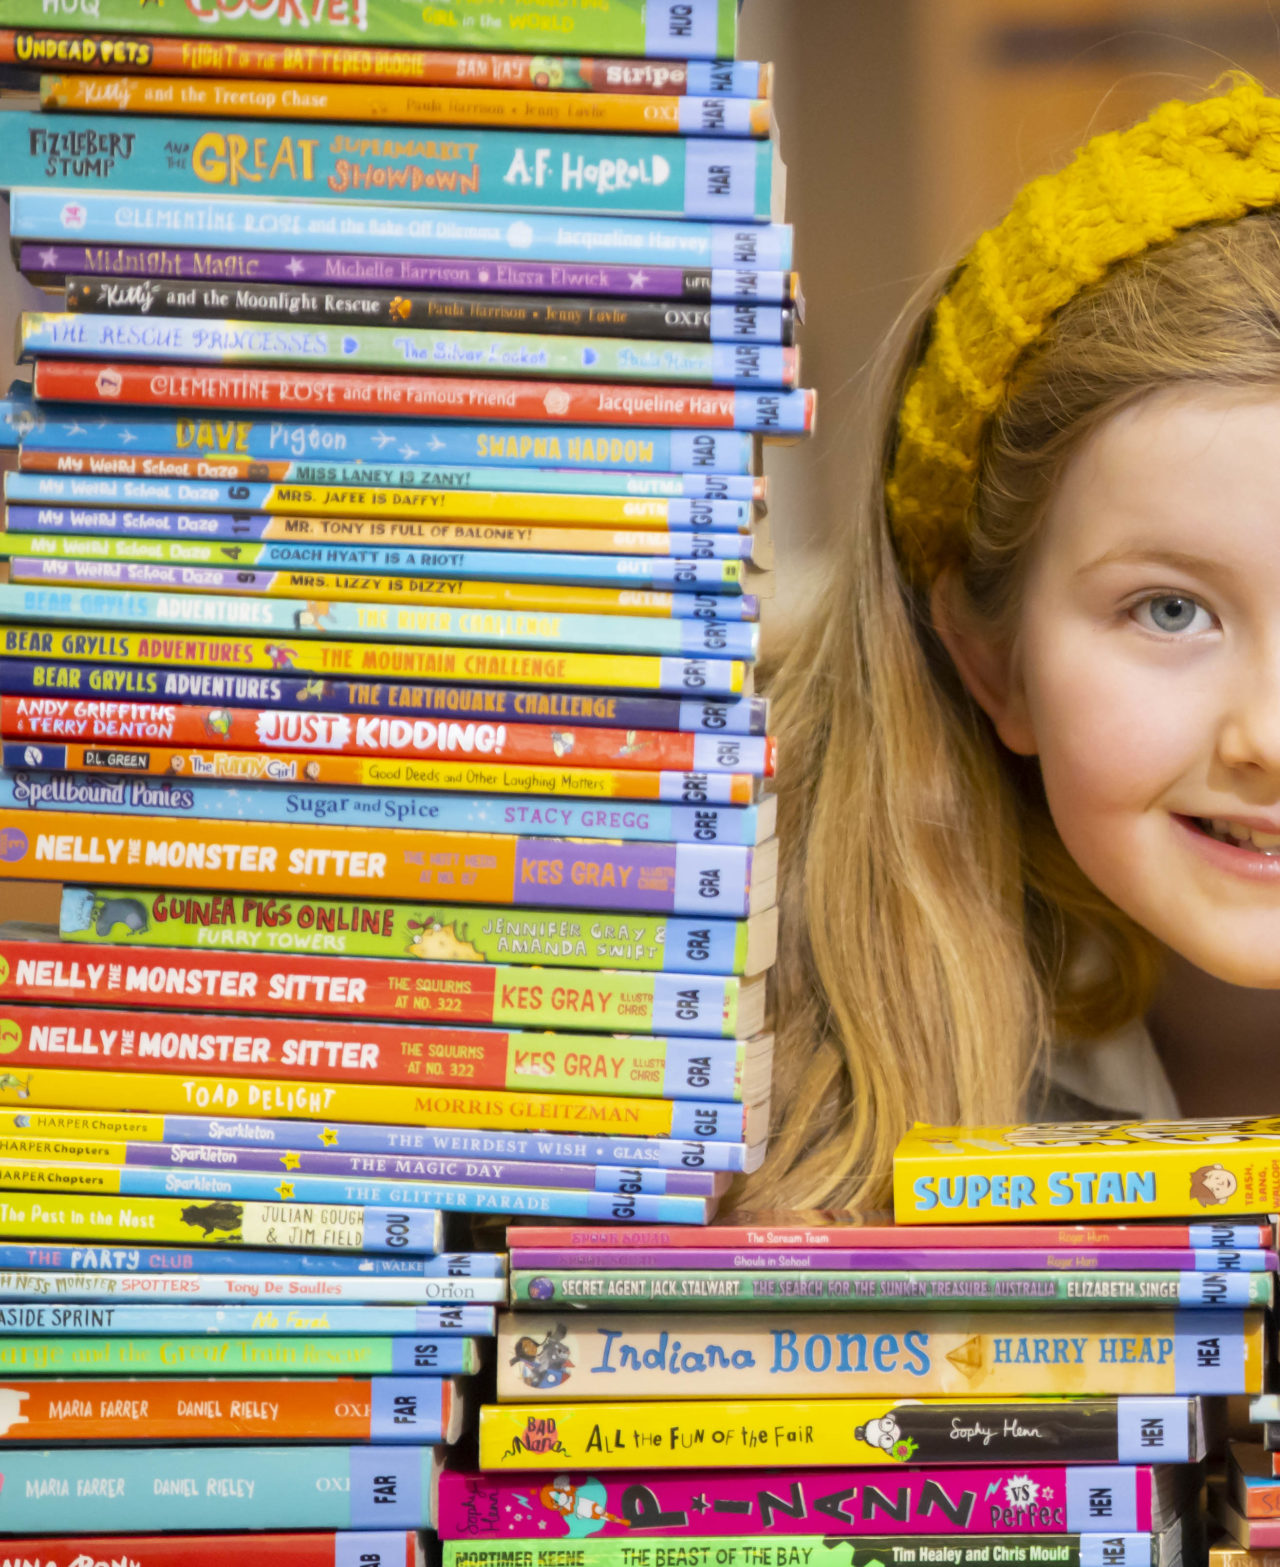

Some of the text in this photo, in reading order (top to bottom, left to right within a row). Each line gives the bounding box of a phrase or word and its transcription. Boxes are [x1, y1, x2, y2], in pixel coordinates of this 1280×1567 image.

[16, 36, 150, 65] UNDEAD PETS
[45, 157, 115, 178] STUMP
[191, 132, 320, 186] GREAT
[150, 372, 516, 408] CLEMENTINE ROSE and the Famous Friend
[177, 418, 347, 456] DAVE Pigeon
[477, 434, 655, 464] SWAPNA HADDOW
[277, 489, 317, 502] MRS.
[372, 492, 387, 504] IS
[392, 493, 445, 507] DAFFY!
[270, 548, 464, 567] COACH HYATT IS A RIOT!
[5, 631, 567, 679] BEAR GRYLLS ADVENTURES THE MOUNTAIN CHALLENGE
[17, 701, 176, 722] ANDY GRIFFITHS
[29, 718, 173, 739] TERRY DENTON
[264, 713, 507, 754] JUST KIDDING!
[13, 774, 194, 809] Spellbound Ponies
[286, 795, 440, 822] Sugar and Spice
[504, 807, 650, 830] STACY GREGG
[35, 834, 388, 879] NELLY THE MONSTER SITTER
[521, 860, 633, 888] KES GRAY
[698, 869, 721, 898] GRA
[152, 895, 395, 937] GUINEA PIGS ONLINE
[198, 928, 347, 951] FURRY TOWERS
[182, 1081, 336, 1113] TOAD DELIGHT
[413, 1097, 640, 1123] MORRIS GLEITZMAN
[913, 1171, 1157, 1211] SUPER STAN
[262, 1206, 365, 1226] JULIAN GOUGH
[425, 1281, 475, 1300] Orion
[562, 1280, 740, 1300] SECRET AGENT JACK STALWART
[590, 1328, 756, 1375] Indiana
[993, 1336, 1174, 1365] HARRY HEAP
[1198, 1337, 1221, 1368] HEA
[49, 1399, 149, 1420] MARIA FARRER
[177, 1400, 279, 1421] DANIEL RIELEY
[394, 1395, 417, 1424] FAR
[1141, 1418, 1164, 1448] HEN
[621, 1547, 813, 1566] THE BEAST OF THE BAY
[892, 1545, 1070, 1565] Tim Healey and Chris Mould
